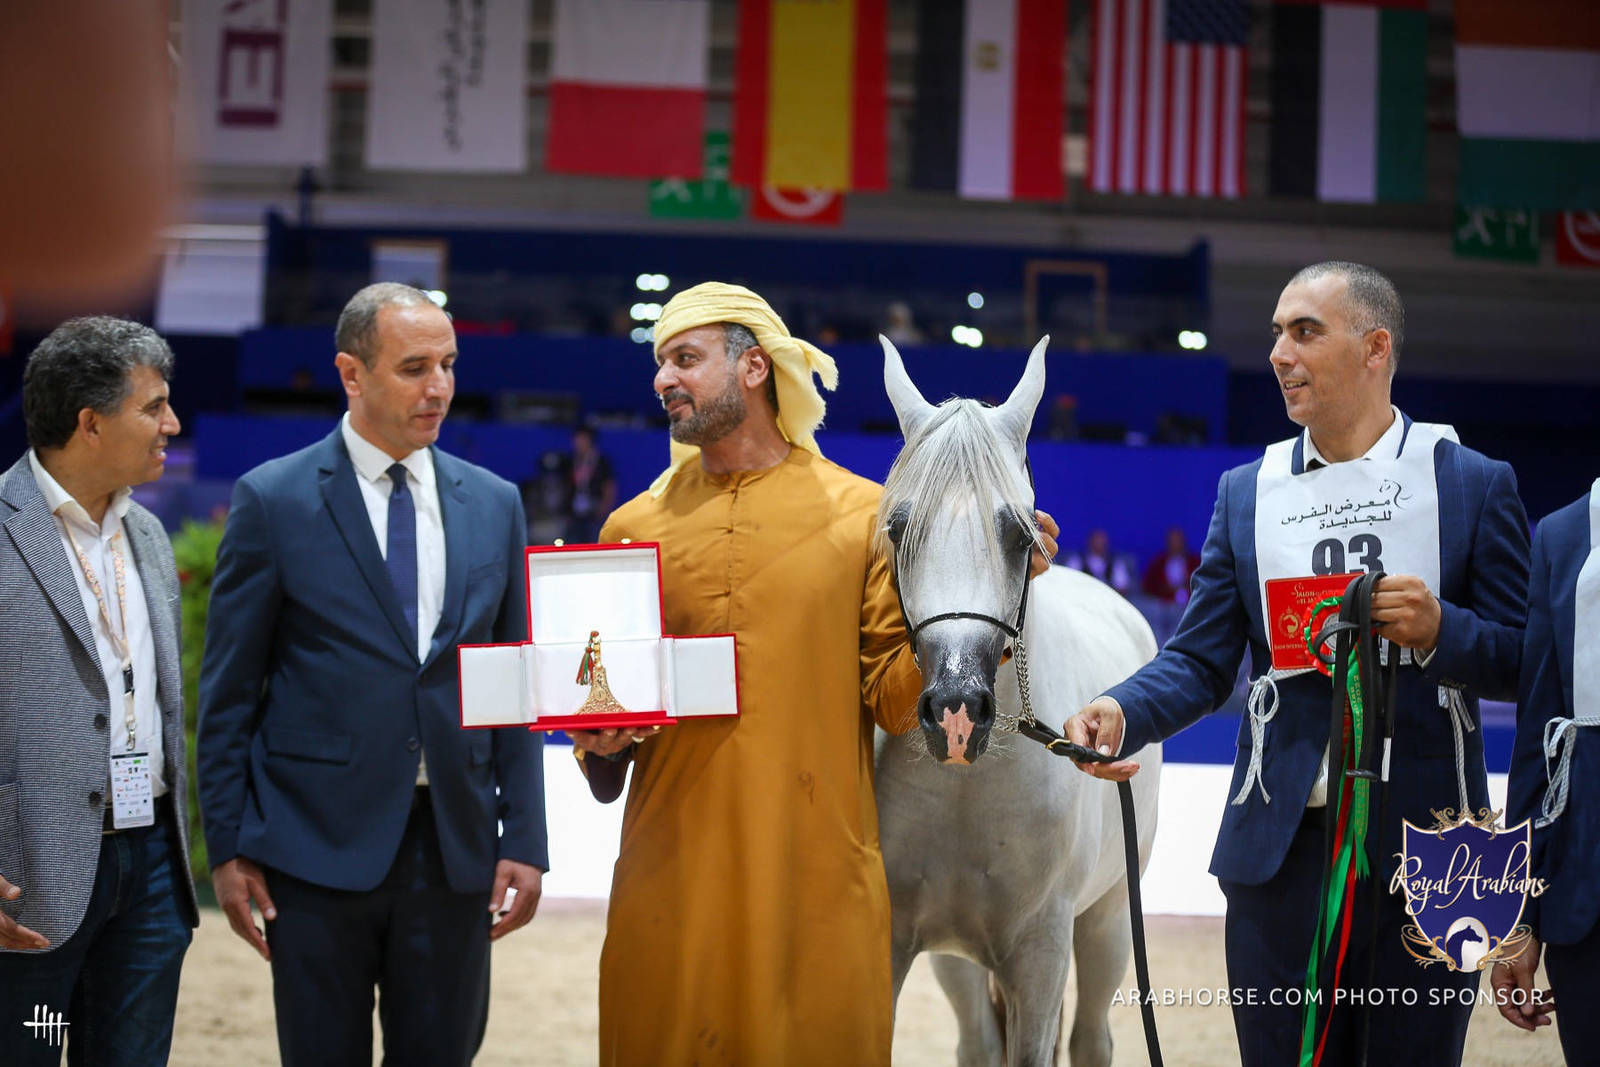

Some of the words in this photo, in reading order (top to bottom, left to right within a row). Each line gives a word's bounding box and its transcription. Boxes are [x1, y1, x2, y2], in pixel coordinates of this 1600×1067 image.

[1281, 504, 1332, 524] الفرس
[1334, 498, 1391, 516] معرض
[1319, 510, 1392, 530] للجديدة
[1311, 533, 1384, 576] 93
